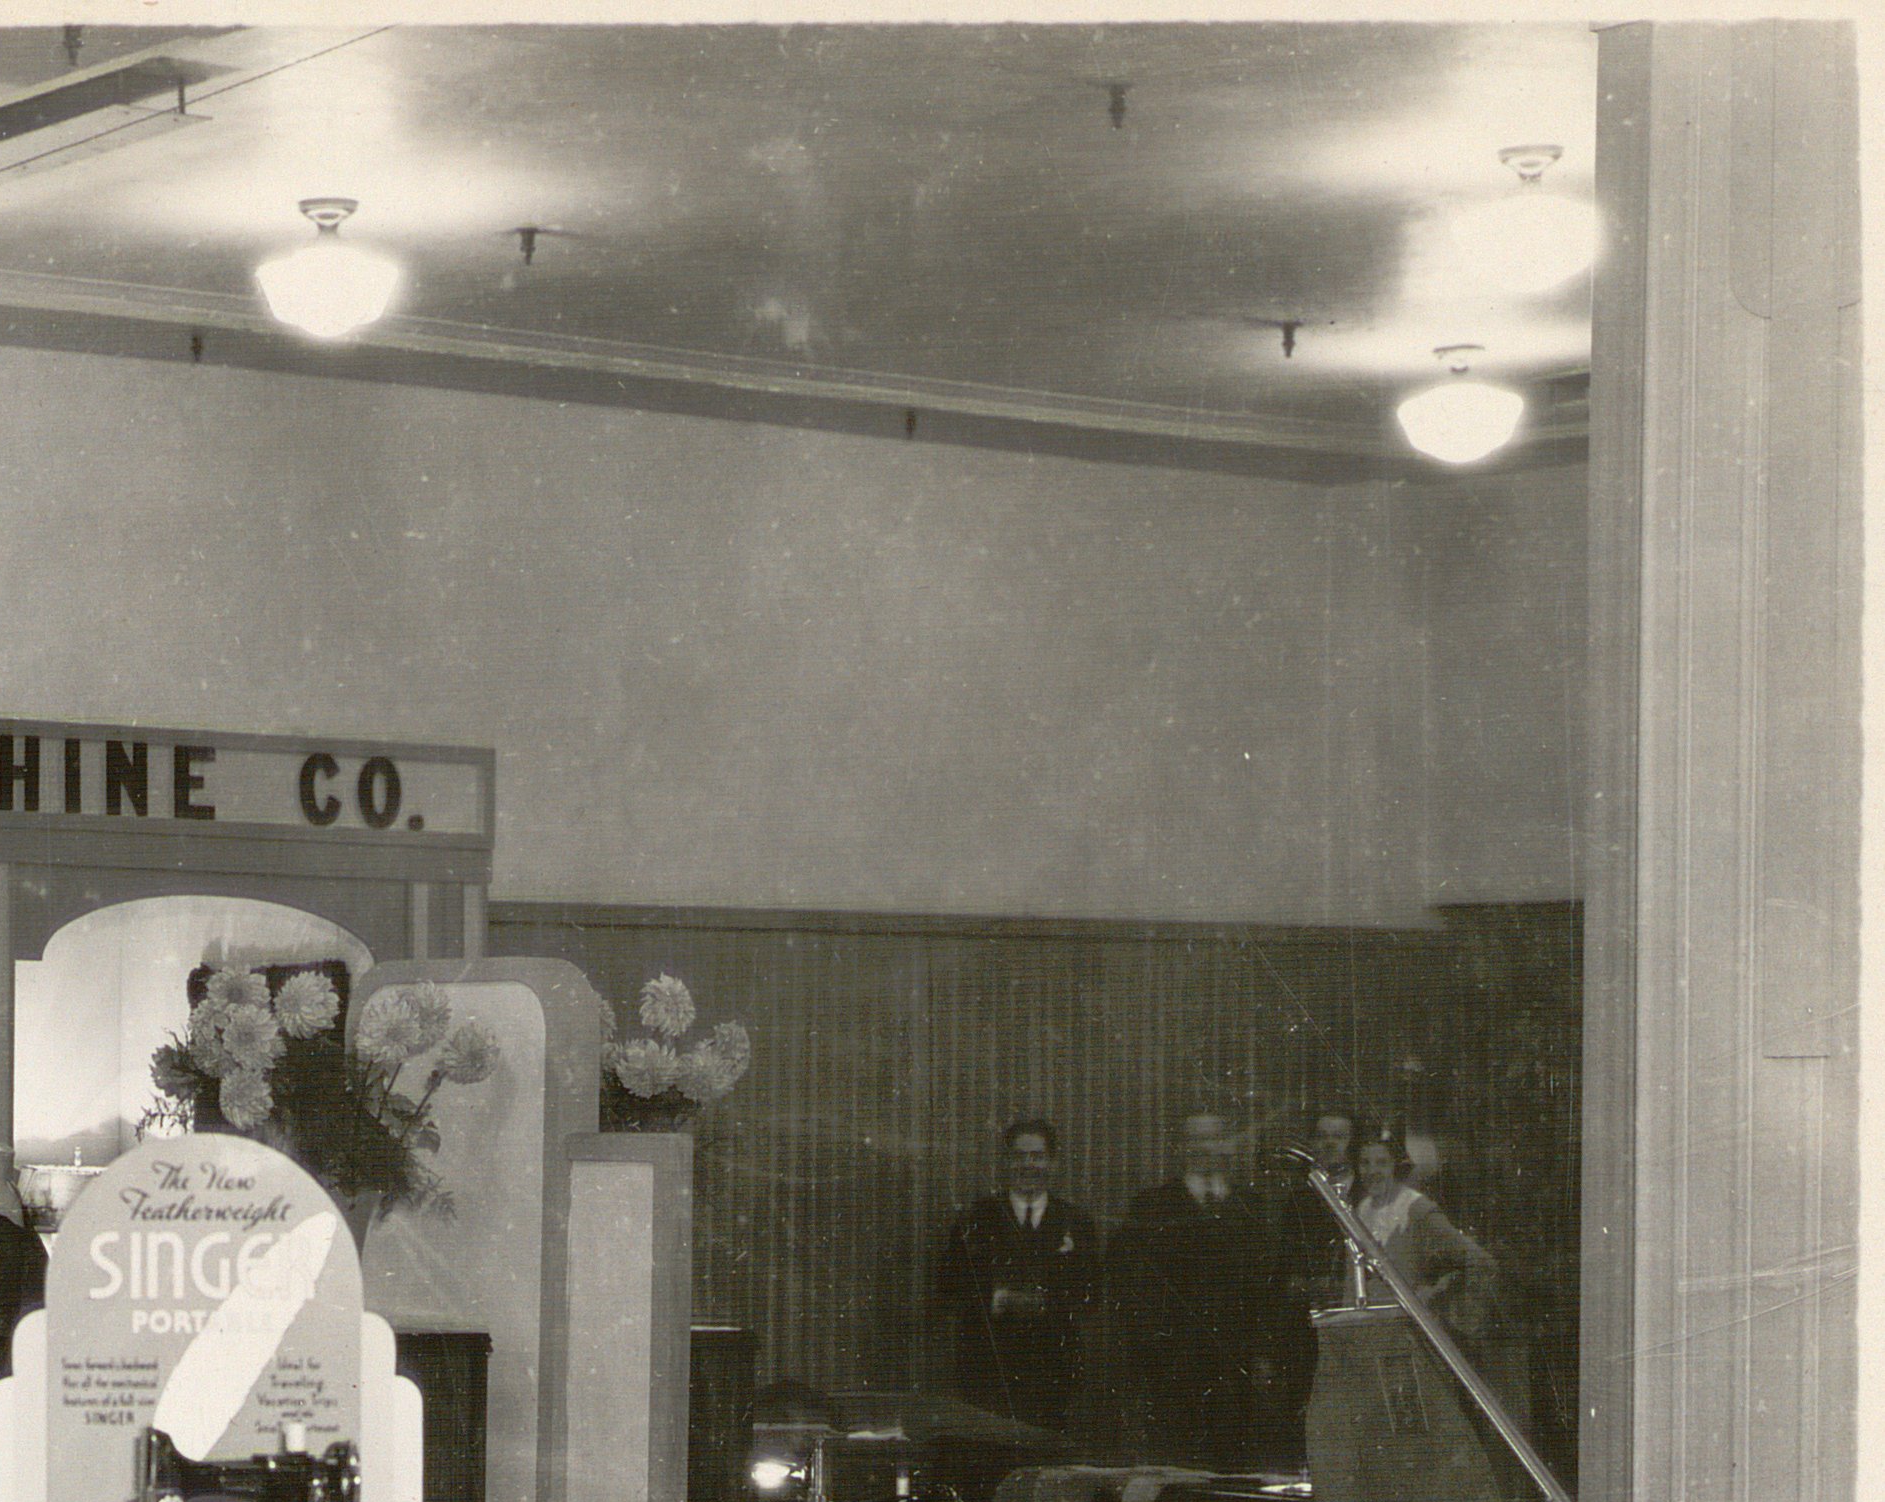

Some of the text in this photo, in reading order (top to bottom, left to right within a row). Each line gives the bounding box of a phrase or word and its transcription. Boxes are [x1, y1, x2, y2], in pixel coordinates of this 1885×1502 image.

[297, 752, 426, 833] CO.
[151, 1159, 256, 1191] The New
[119, 1186, 292, 1231] Featherweight
[88, 1230, 315, 1300] SINGE
[84, 1410, 134, 1425] SINGER
